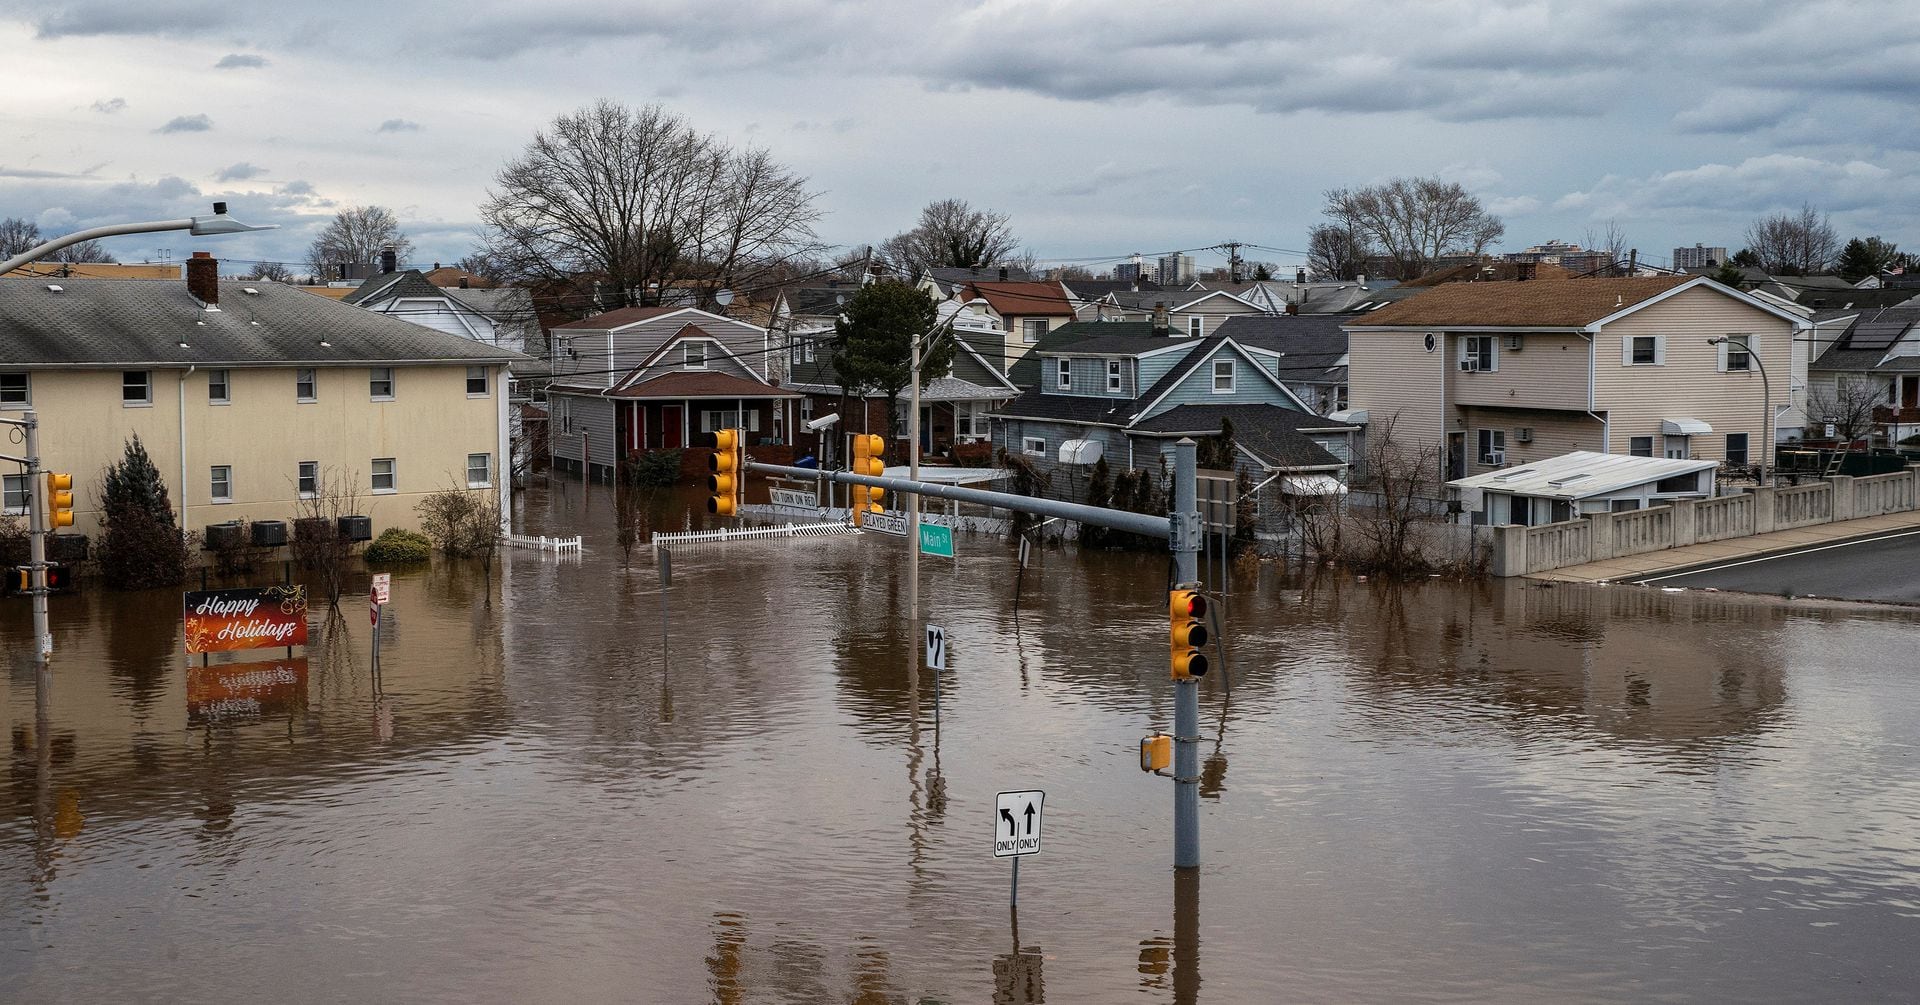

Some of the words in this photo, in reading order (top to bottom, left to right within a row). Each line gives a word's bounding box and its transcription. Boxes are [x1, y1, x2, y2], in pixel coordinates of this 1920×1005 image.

[772, 491, 779, 501] NO
[780, 492, 794, 503] TURN
[795, 494, 803, 504] ON
[804, 496, 815, 506] RED
[862, 514, 886, 529] DELAYED
[888, 518, 905, 533] GREEN
[923, 531, 941, 547] Main
[196, 596, 259, 618] Happy
[218, 619, 297, 640] Holidays
[997, 840, 1016, 851] ONLY
[1020, 838, 1038, 849] ONLY
